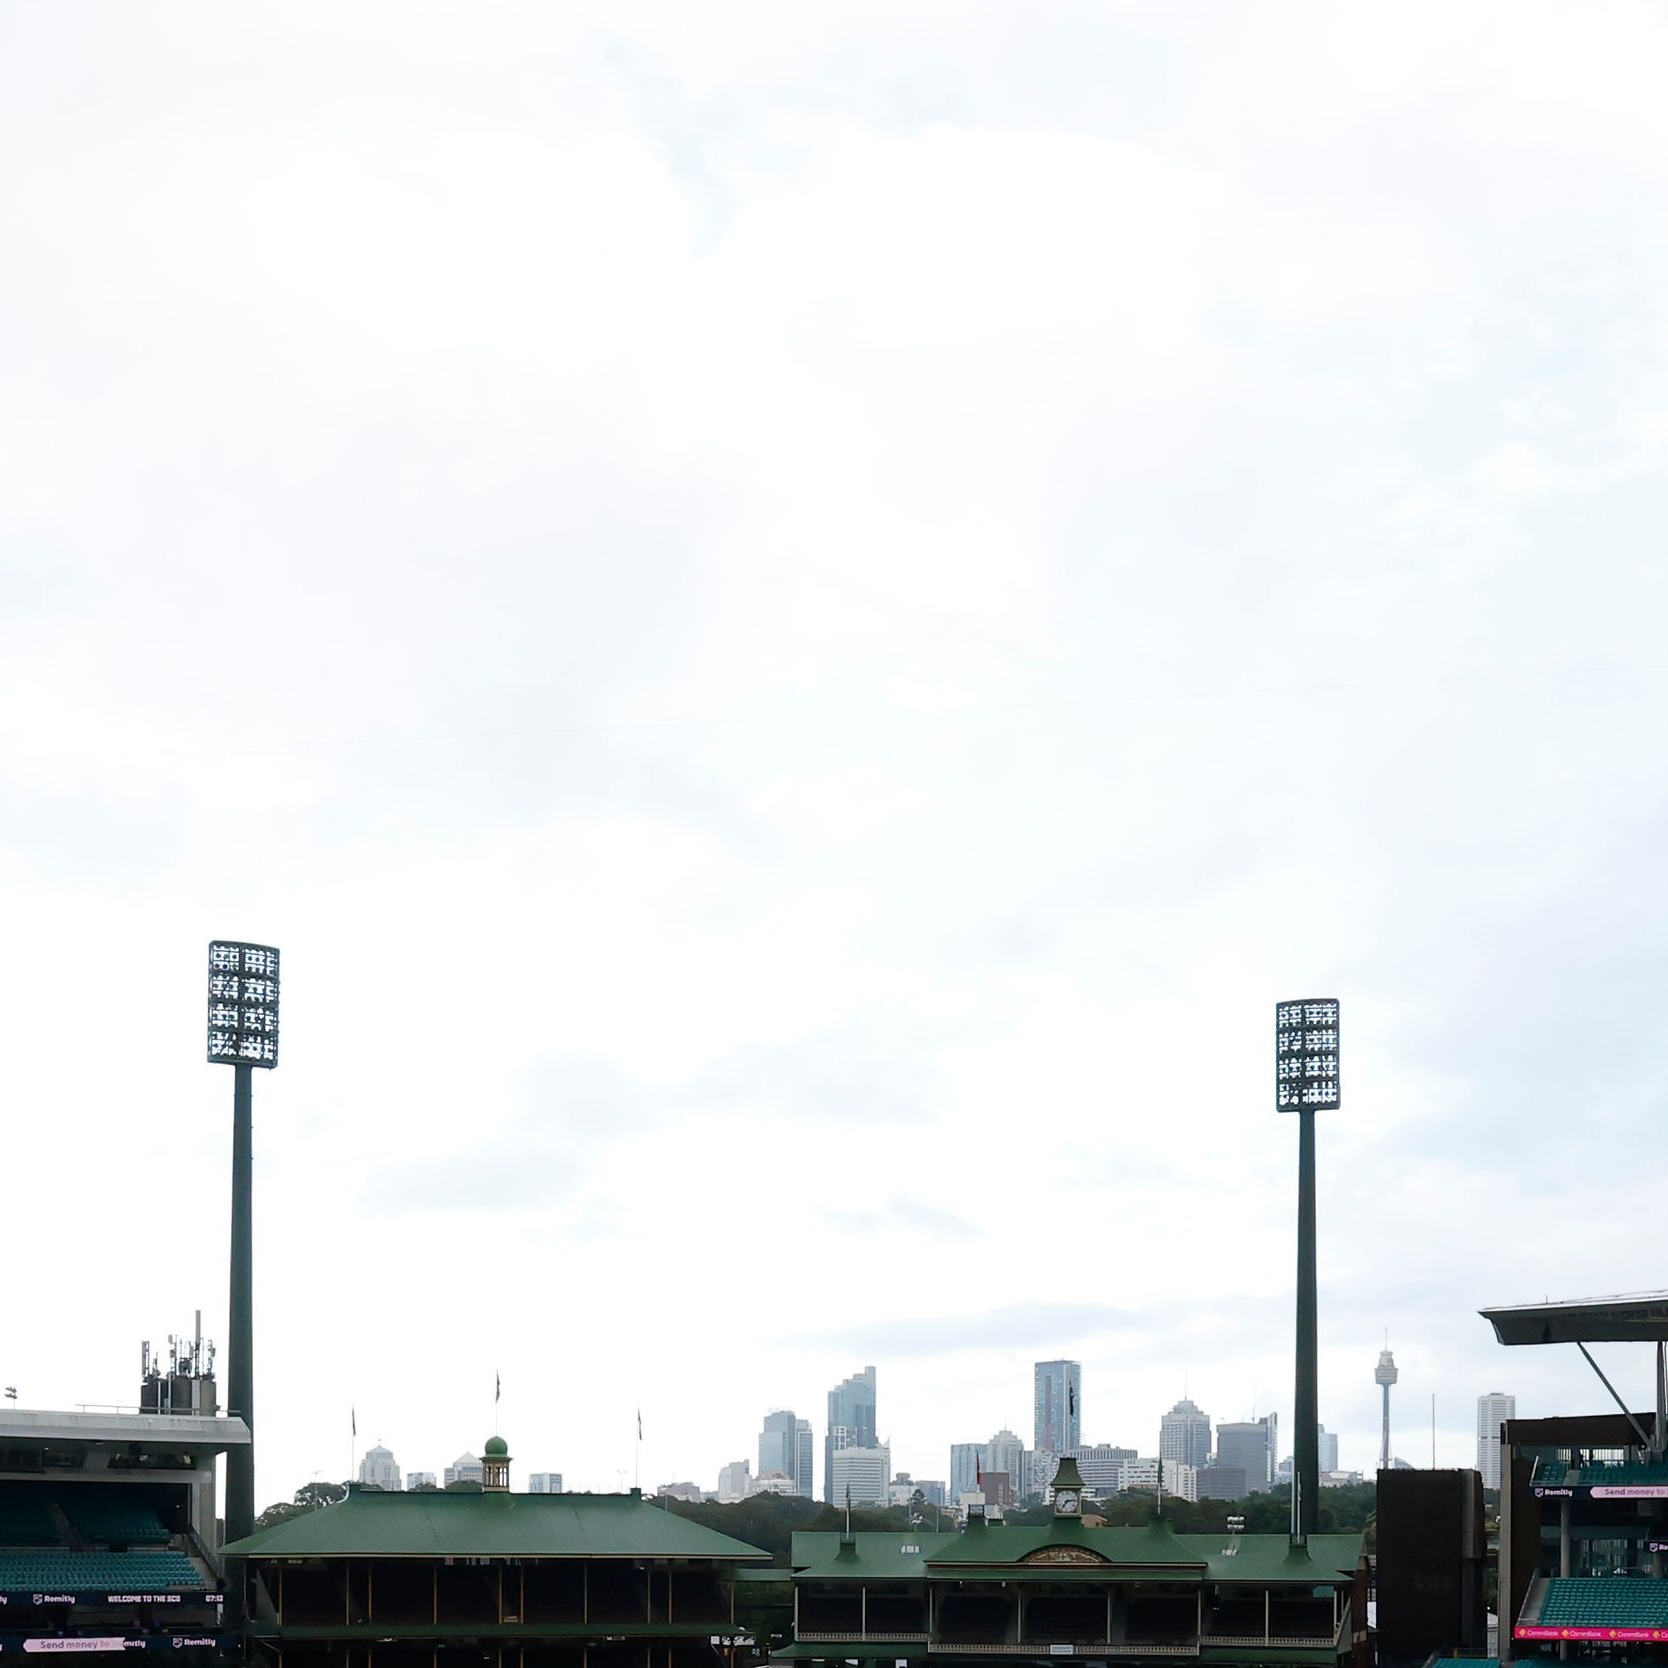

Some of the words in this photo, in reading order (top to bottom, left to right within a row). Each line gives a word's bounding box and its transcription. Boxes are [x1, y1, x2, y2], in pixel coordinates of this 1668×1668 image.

[44, 1594, 75, 1605] Remitly
[107, 1595, 141, 1603] WELCOME
[153, 1595, 165, 1603] THE
[184, 1638, 216, 1648] Remitly
